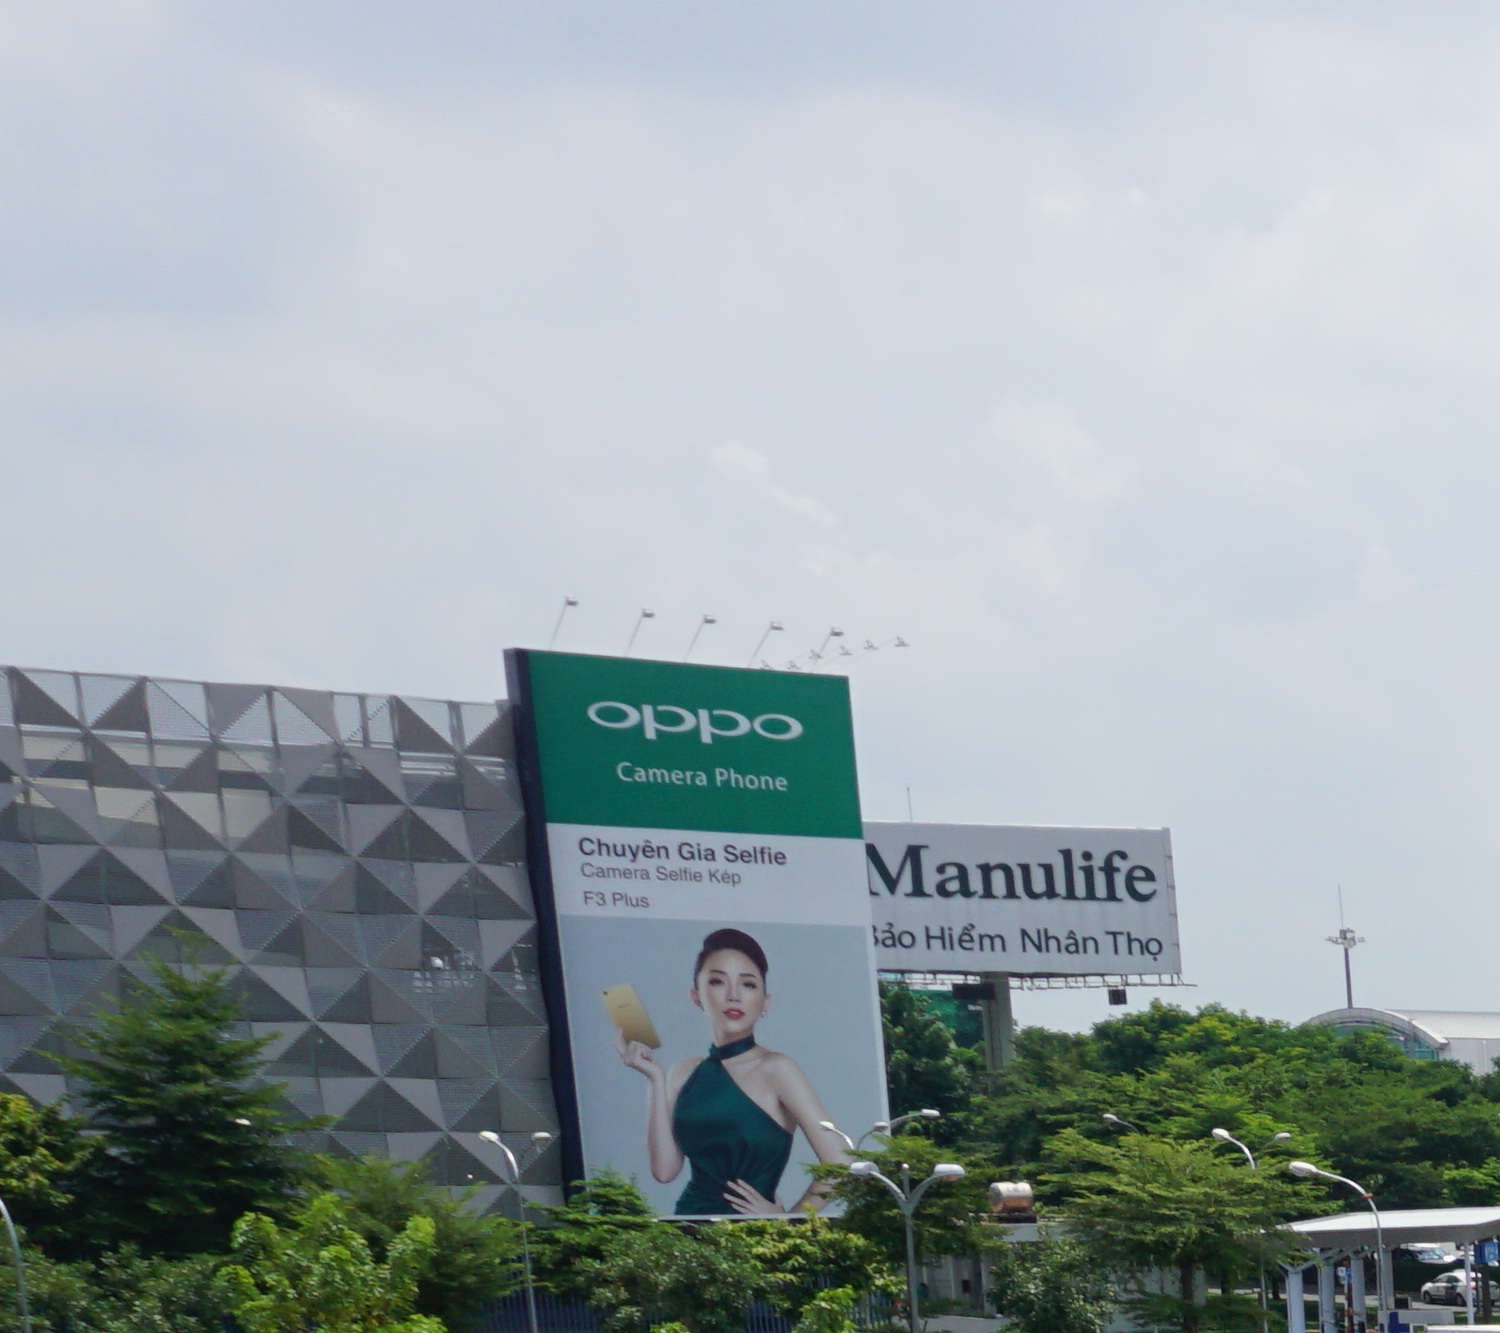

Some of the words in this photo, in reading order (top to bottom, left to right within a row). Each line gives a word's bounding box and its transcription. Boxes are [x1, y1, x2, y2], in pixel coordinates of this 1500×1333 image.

[587, 701, 803, 743] oppo
[617, 761, 708, 788] Camera
[715, 769, 788, 792] Phone
[578, 837, 670, 863] Chuyên
[677, 841, 717, 862] Gia
[724, 844, 787, 866] Selfie
[580, 862, 651, 880] Camera
[656, 866, 703, 882] Selfie
[708, 866, 742, 887] Kép
[869, 843, 1158, 902] Manulife
[584, 891, 607, 906] F3
[613, 892, 651, 909] Plus
[927, 922, 1007, 954] Hiểm
[1020, 929, 1093, 955] Nhân
[1098, 929, 1164, 960] Thọ
